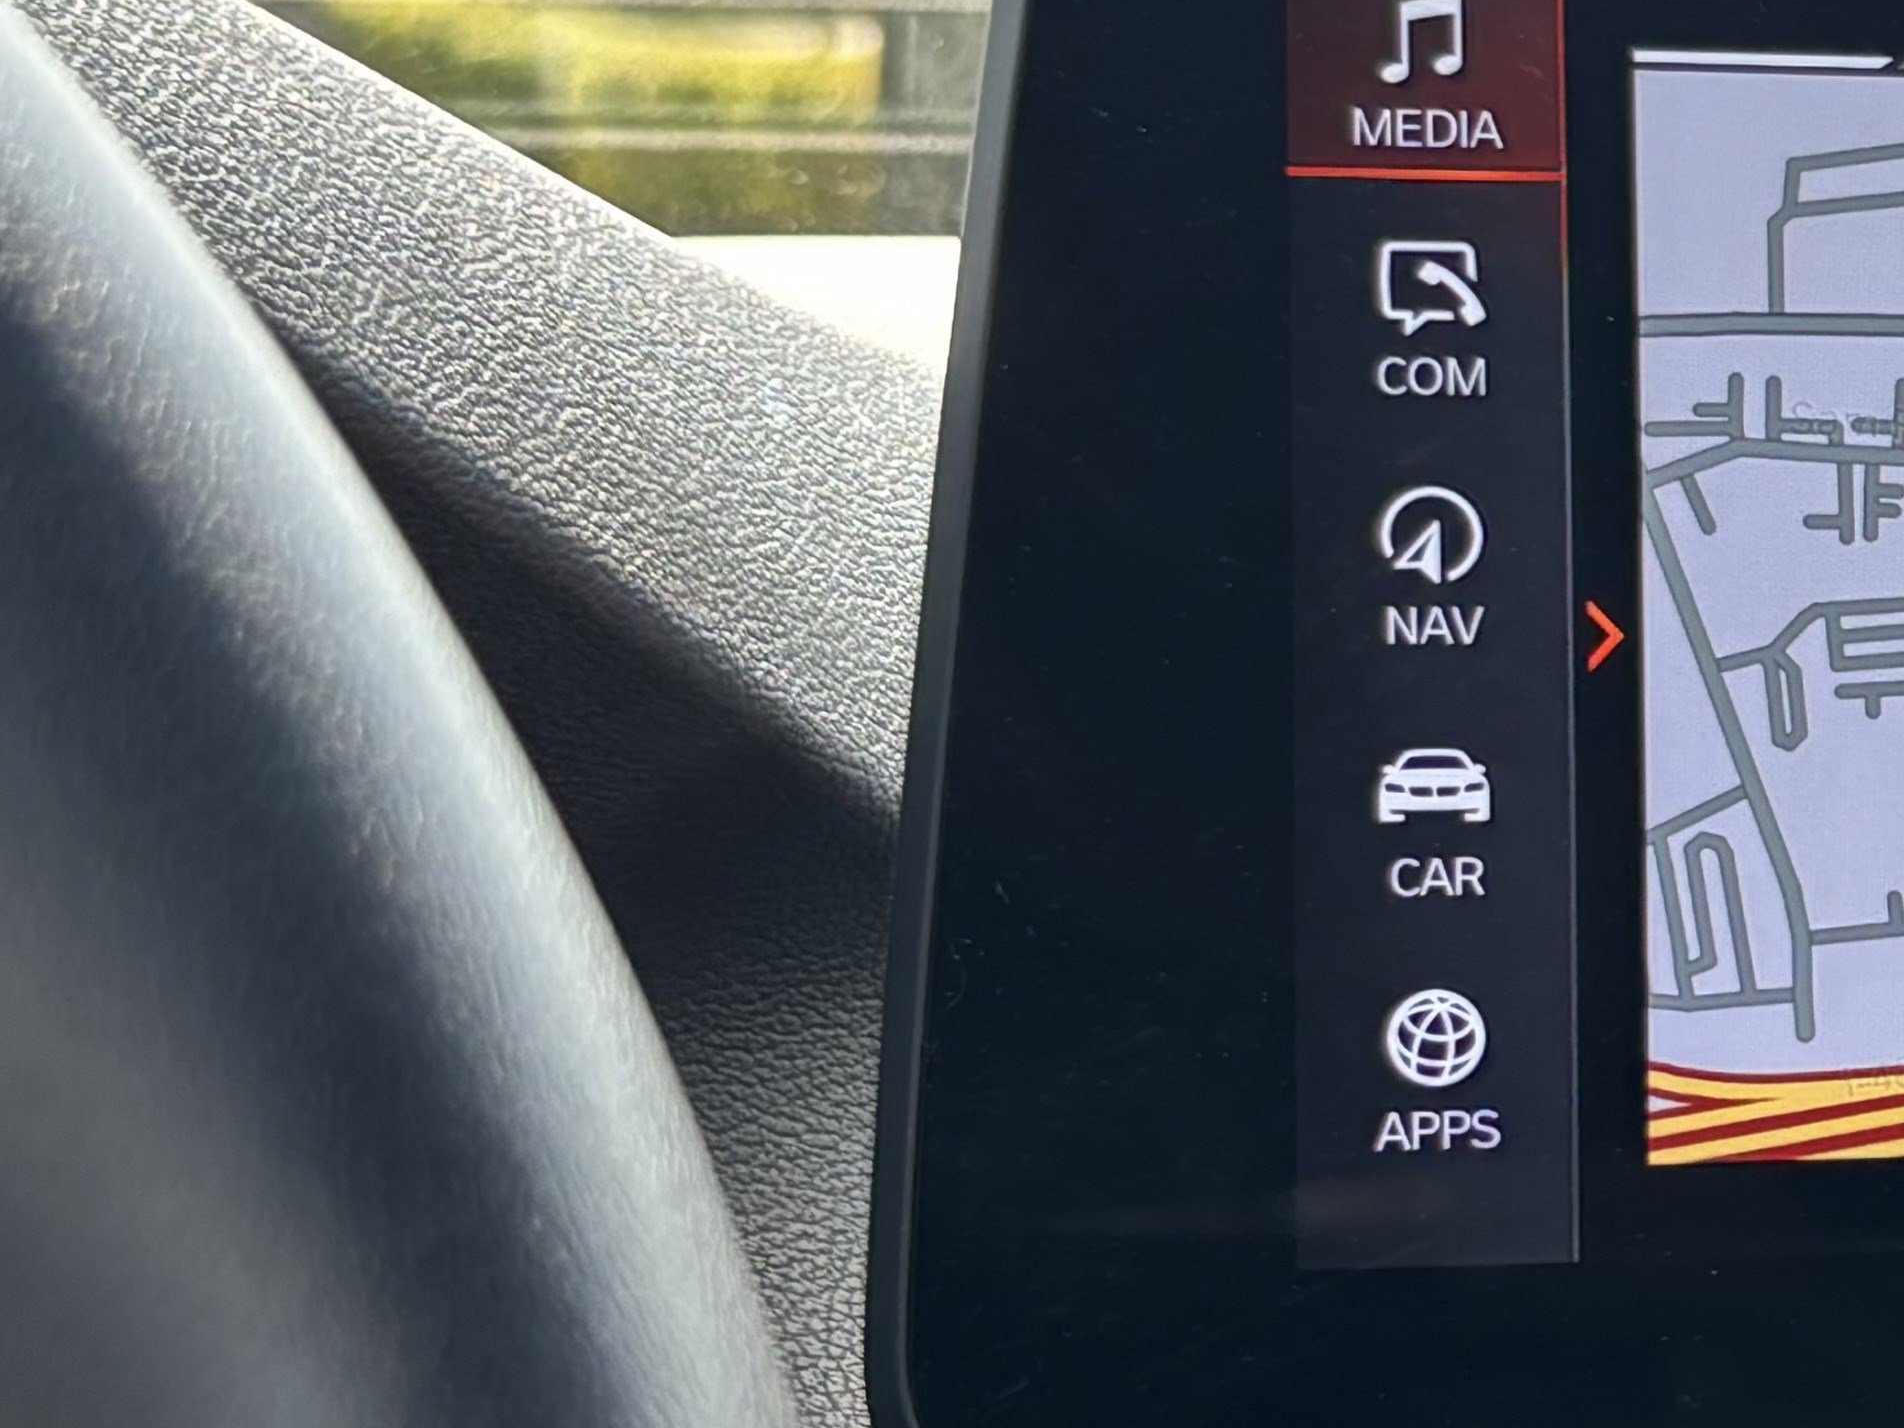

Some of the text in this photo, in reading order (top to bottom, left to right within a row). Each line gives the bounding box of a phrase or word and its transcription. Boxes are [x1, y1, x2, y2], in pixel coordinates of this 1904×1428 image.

[1351, 106, 1505, 150] MEDIA
[1375, 355, 1487, 397] COM
[1385, 604, 1486, 646] NAV
[1389, 855, 1486, 898] CAR
[1374, 1108, 1502, 1153] APPS
